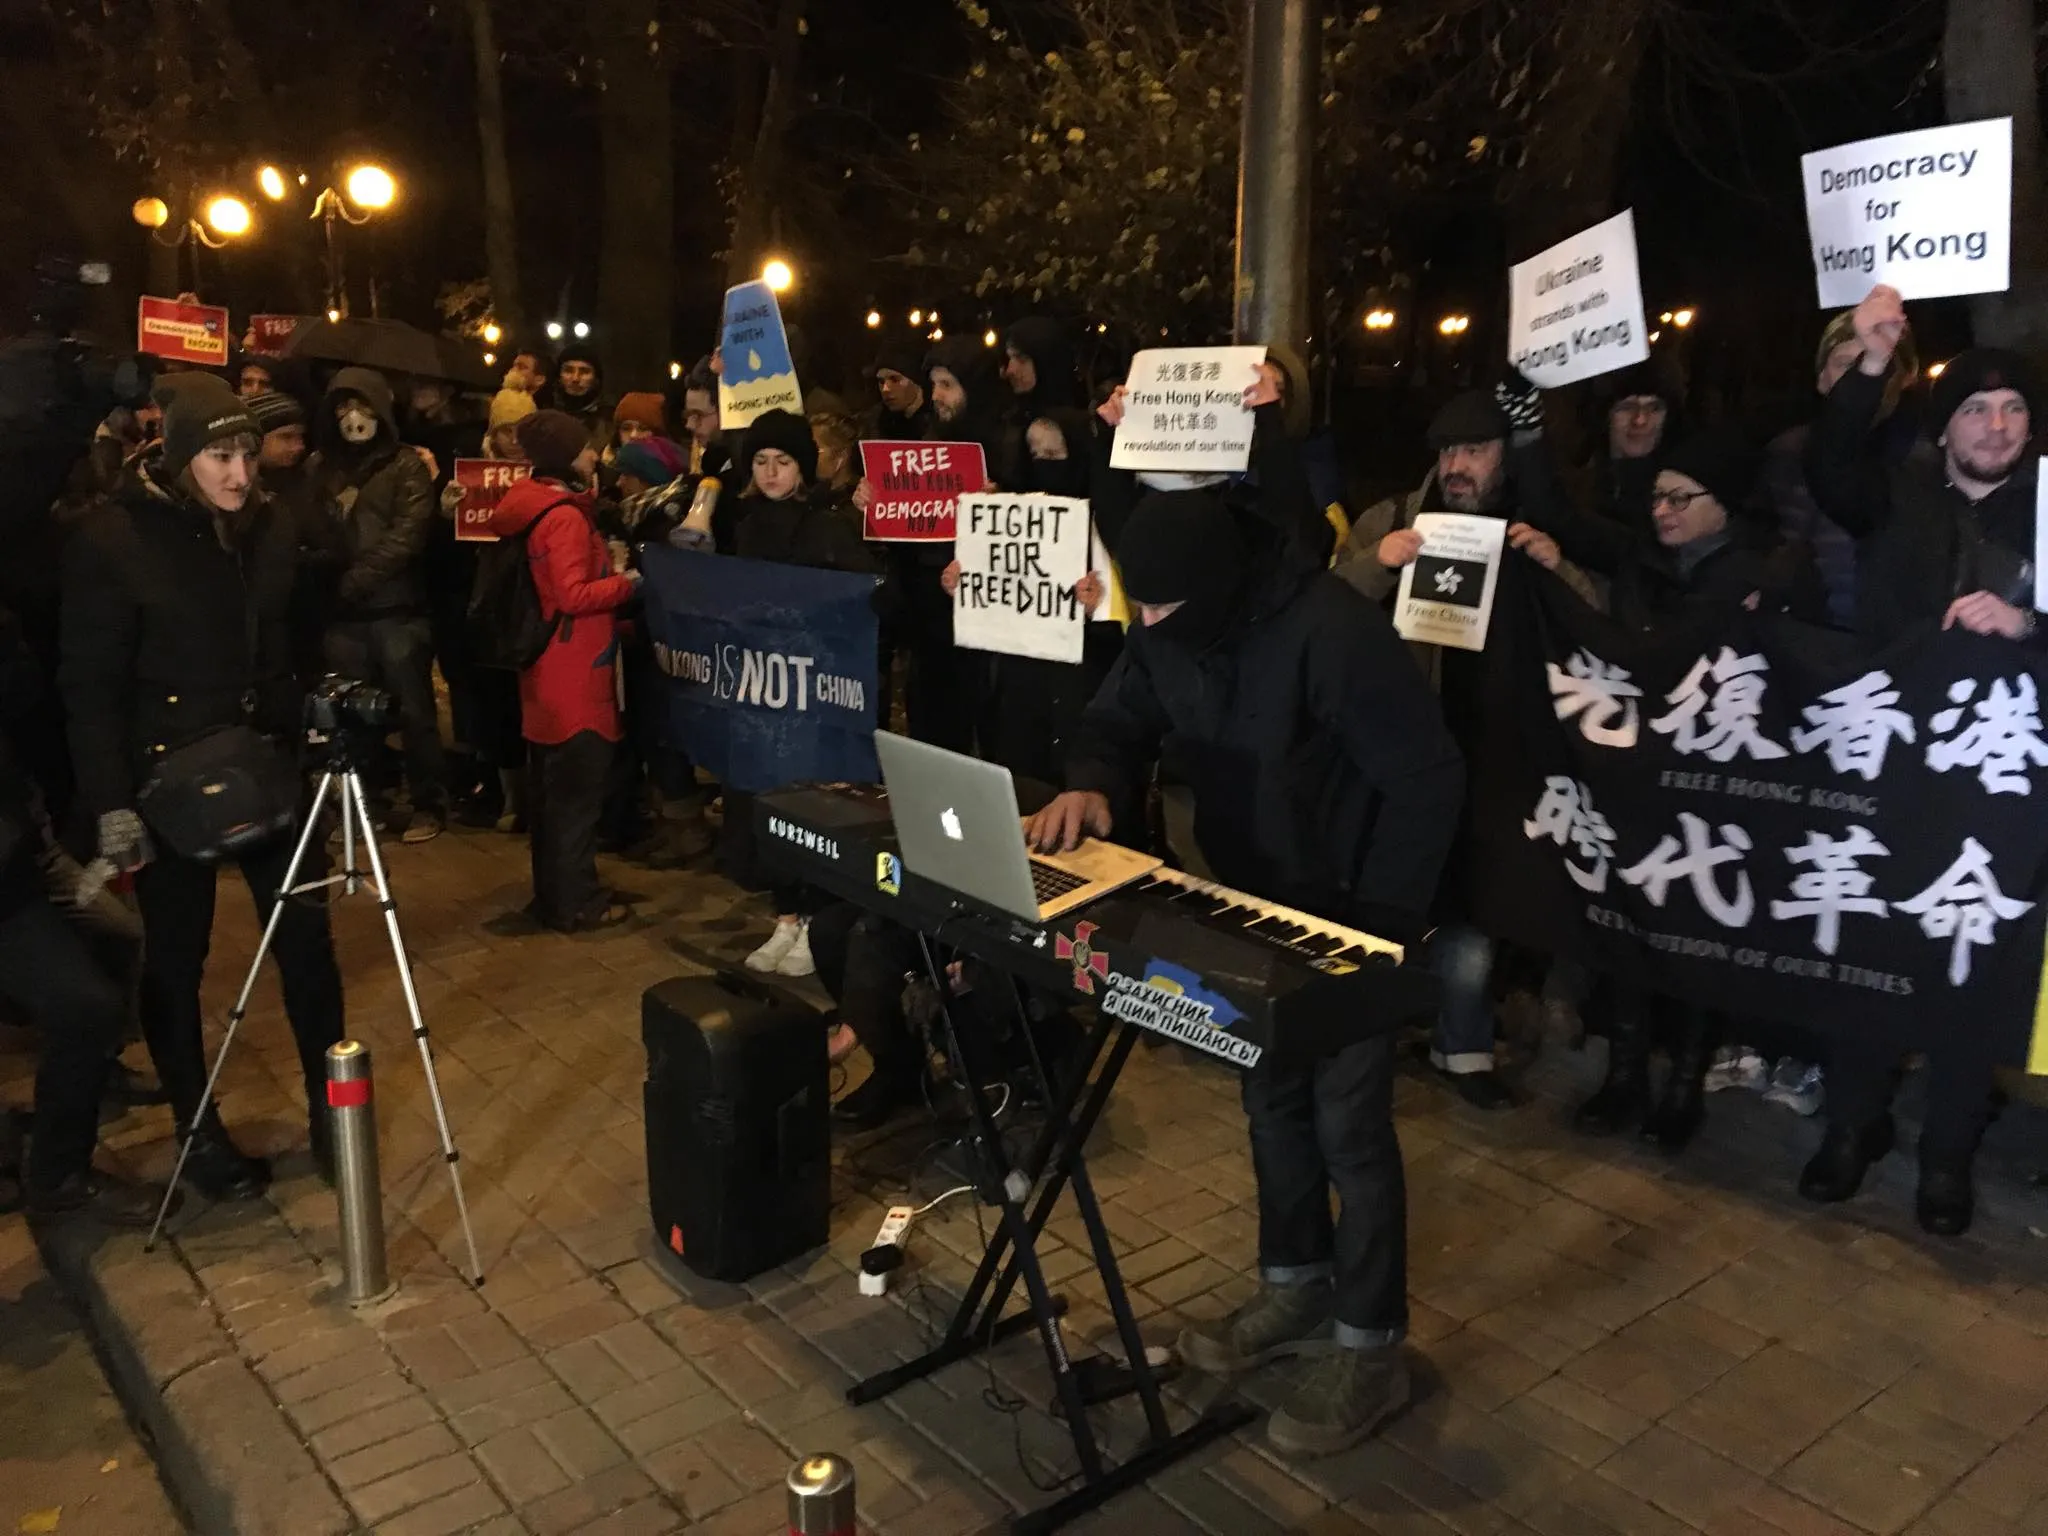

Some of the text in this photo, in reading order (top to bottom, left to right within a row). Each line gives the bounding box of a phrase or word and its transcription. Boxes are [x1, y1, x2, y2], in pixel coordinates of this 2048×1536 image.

[1820, 149, 1978, 195] Democracy
[1865, 199, 1901, 222] for
[1820, 230, 1988, 273] Hong Kong
[1535, 253, 1604, 296] Ukraine
[1577, 289, 1609, 313] with
[187, 337, 219, 350] NOW
[731, 327, 765, 345] WITH
[1515, 319, 1631, 370] Hong Kong
[1155, 361, 1222, 382] 光復香港
[728, 391, 796, 412] HONG KONG
[1133, 389, 1242, 407] Free Hong Kong
[1153, 411, 1217, 432] 時代革命
[1124, 439, 1181, 451] revolution
[1185, 439, 1198, 451] of
[1199, 442, 1218, 451] our
[889, 447, 952, 477] FREE
[883, 471, 965, 493] HONG KONG
[874, 498, 956, 521] DEMOCRA
[907, 516, 937, 533] NOW
[970, 503, 1070, 544] FIGHT
[989, 542, 1050, 578] FOR
[958, 571, 1078, 621] FREEDOM
[1406, 602, 1478, 627] Free China
[671, 649, 712, 684] KONG
[712, 642, 738, 699] IS
[736, 648, 814, 711] NOT
[815, 672, 865, 712] CHINA
[1547, 645, 2048, 796] 光復香港
[1658, 769, 1879, 816] FREE HONG KONG
[768, 815, 840, 861] KURZWEIL
[1733, 946, 1768, 969] OF
[1772, 955, 1833, 980] OUR
[1836, 963, 1915, 996] TIMES
[1105, 993, 1263, 1065] Я ЦИМ ПИШАЮСЬ!
